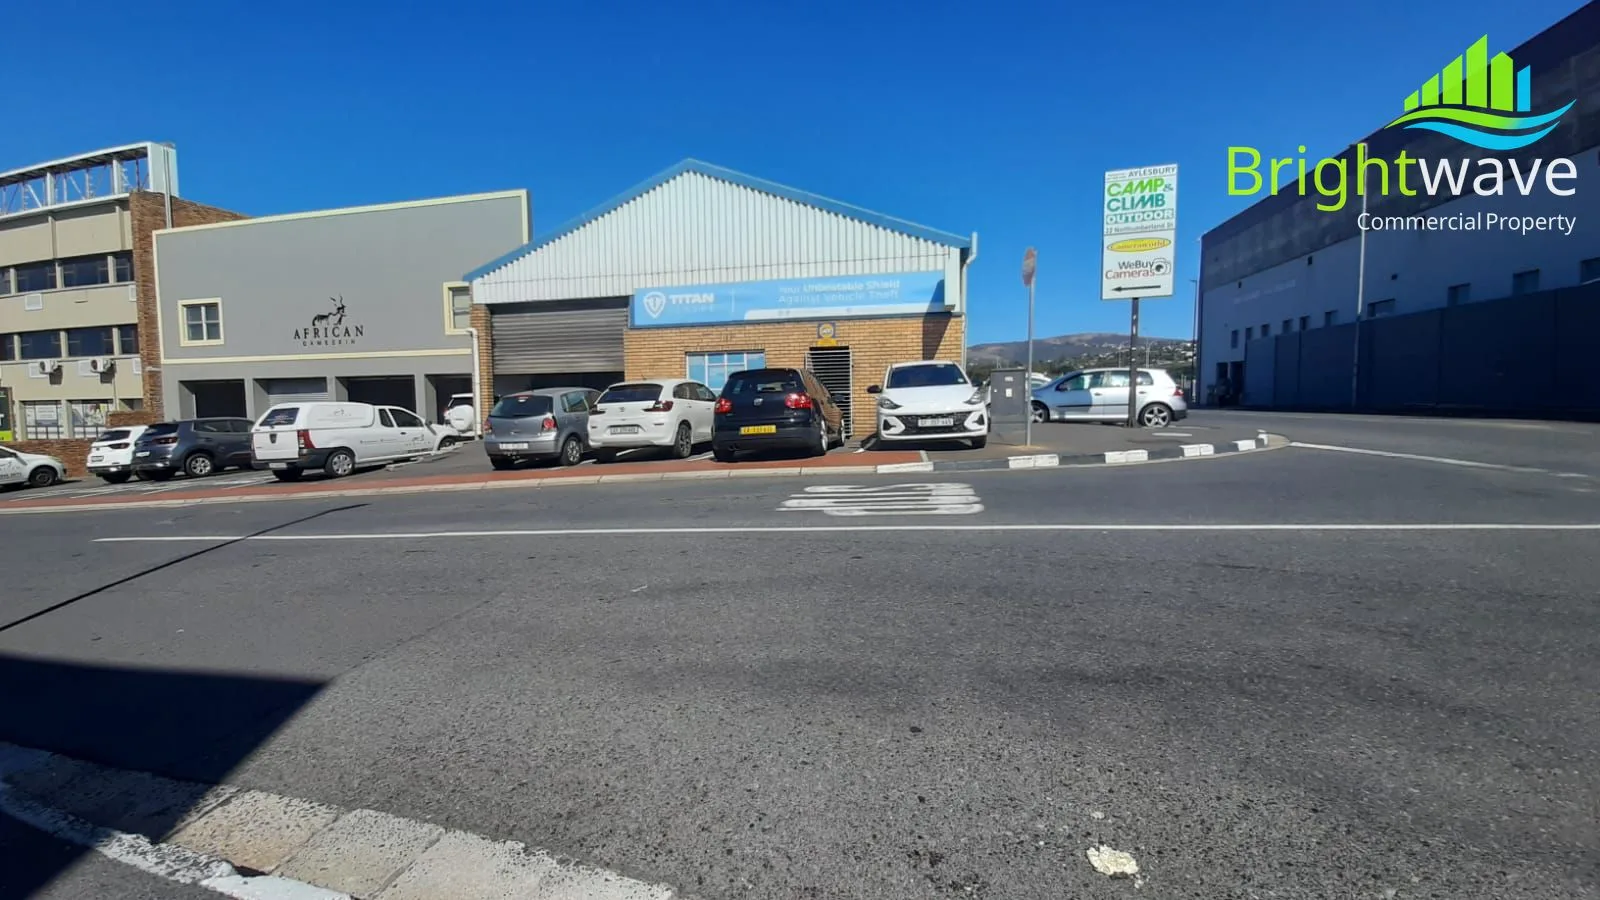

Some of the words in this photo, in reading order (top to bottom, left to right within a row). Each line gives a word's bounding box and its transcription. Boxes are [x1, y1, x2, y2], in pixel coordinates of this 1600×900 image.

[1128, 167, 1175, 177] AYLESBURY
[1107, 193, 1166, 212] CLIMB
[1107, 209, 1174, 225] OUTDOOR
[1105, 269, 1156, 280] Cameras
[669, 292, 715, 305] TITAN
[294, 325, 364, 340] AFRICAN
